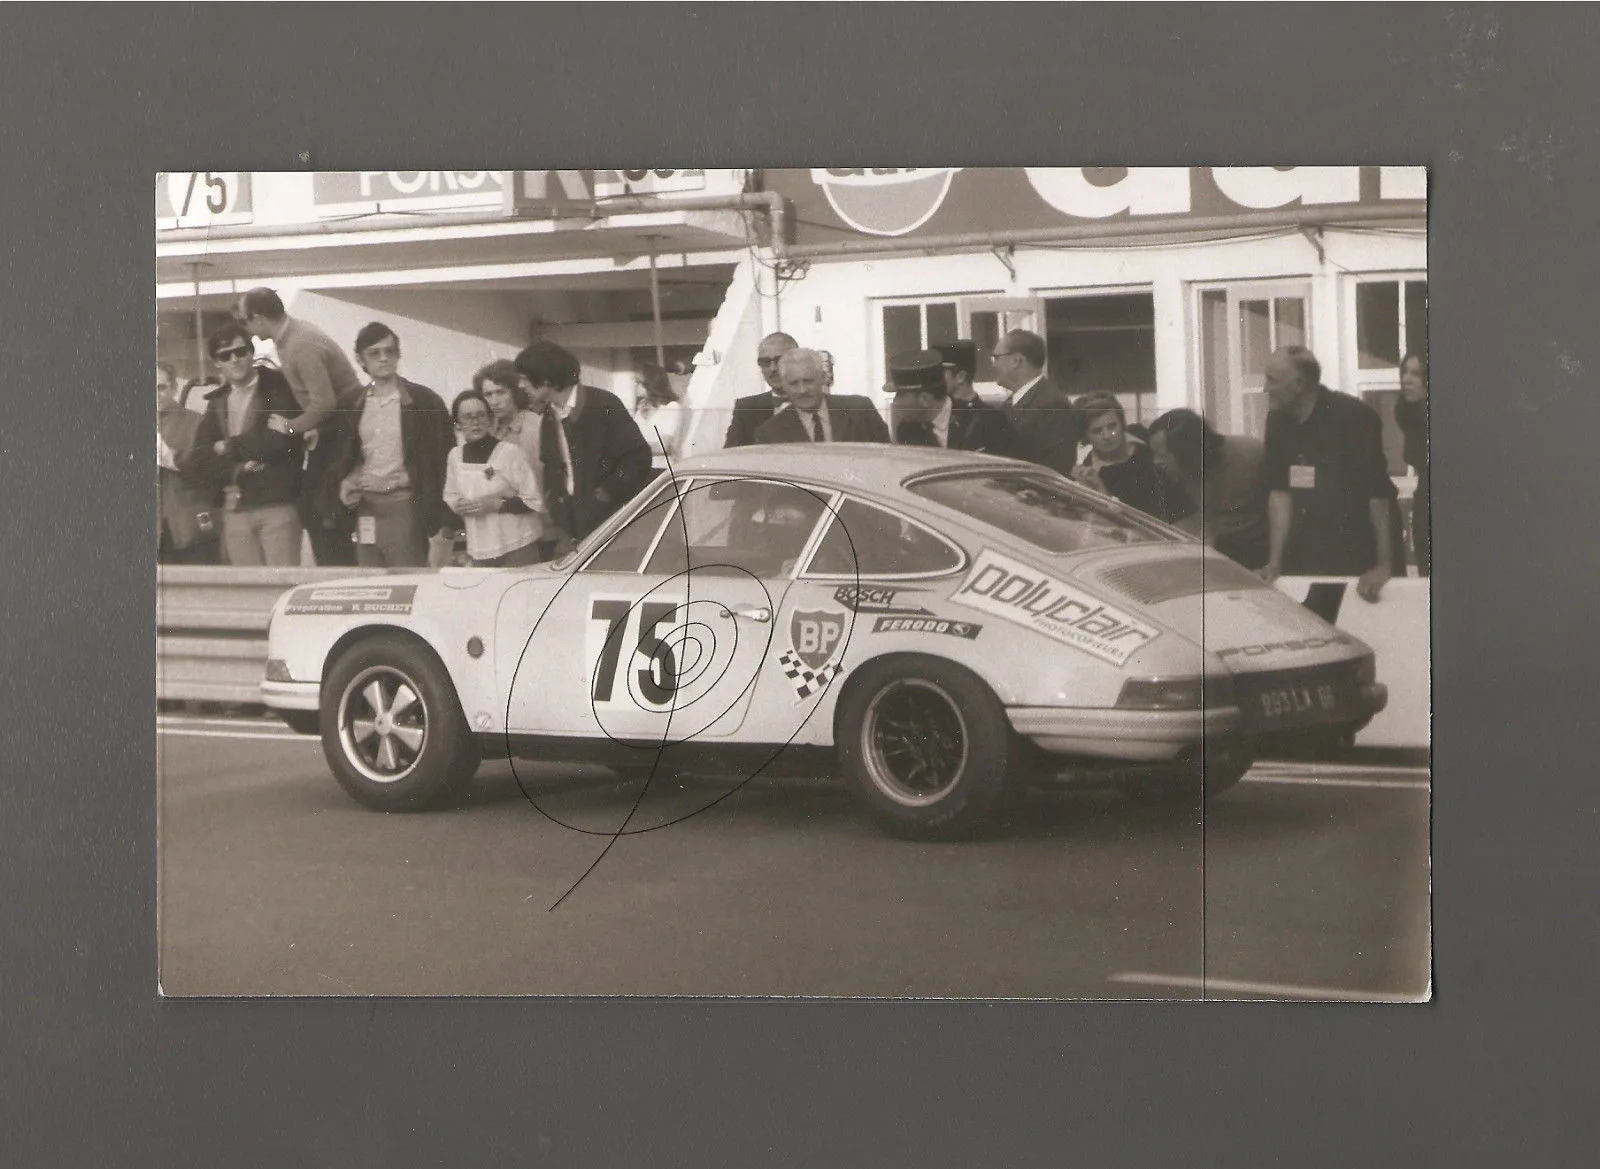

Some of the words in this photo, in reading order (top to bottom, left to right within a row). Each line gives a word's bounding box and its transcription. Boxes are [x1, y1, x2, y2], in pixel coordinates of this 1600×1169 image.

[835, 585, 896, 605] BOSCH
[960, 563, 1149, 642] polyclair
[799, 619, 841, 655] BP
[879, 618, 950, 633] FERODO
[591, 600, 678, 705] 75
